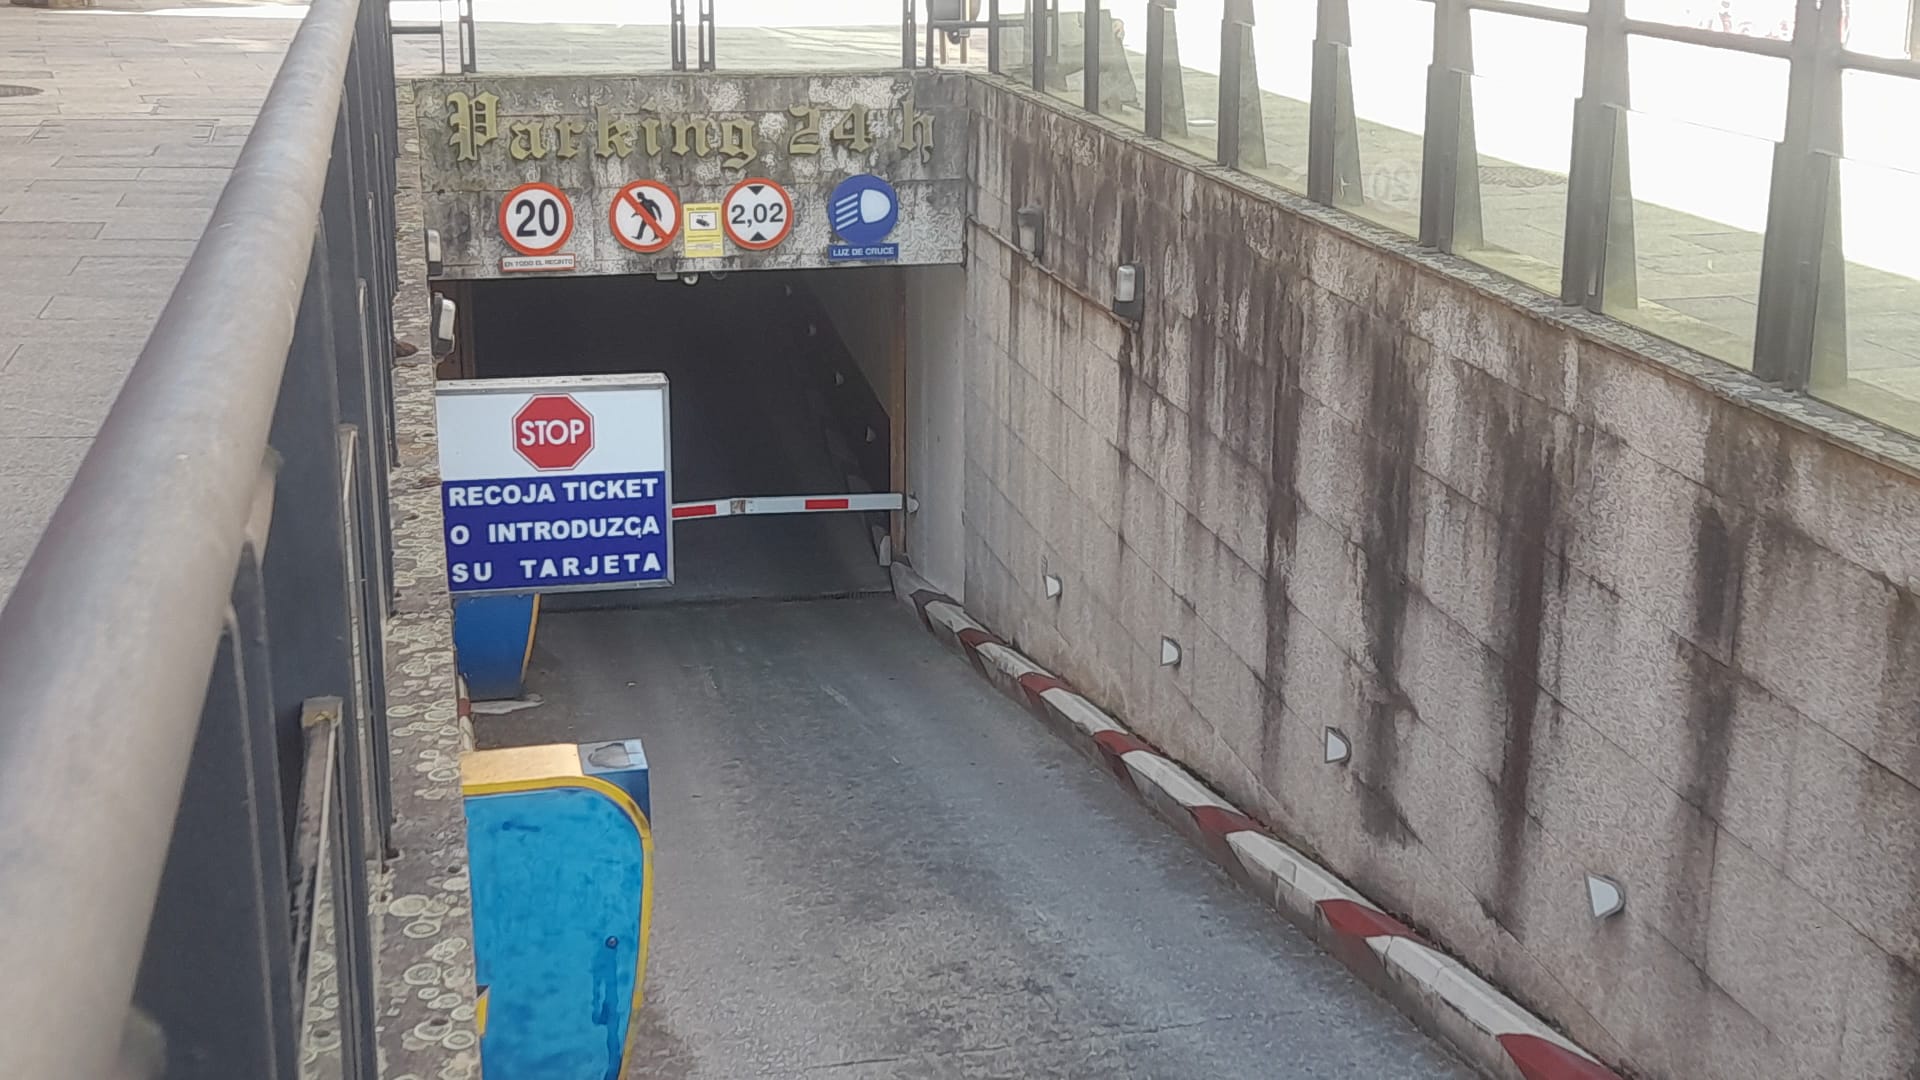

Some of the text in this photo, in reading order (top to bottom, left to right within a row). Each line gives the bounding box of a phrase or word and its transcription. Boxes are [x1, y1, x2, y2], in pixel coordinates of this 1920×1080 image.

[448, 90, 937, 170] Parking 24 h
[515, 198, 560, 237] 20
[731, 203, 784, 228] 2,02
[833, 247, 894, 256] LUZ DE CRUCE
[520, 419, 584, 446] STOP
[449, 478, 659, 506] RECOJA TICKET
[450, 526, 470, 545] O
[452, 553, 661, 583] SU TARJETA
